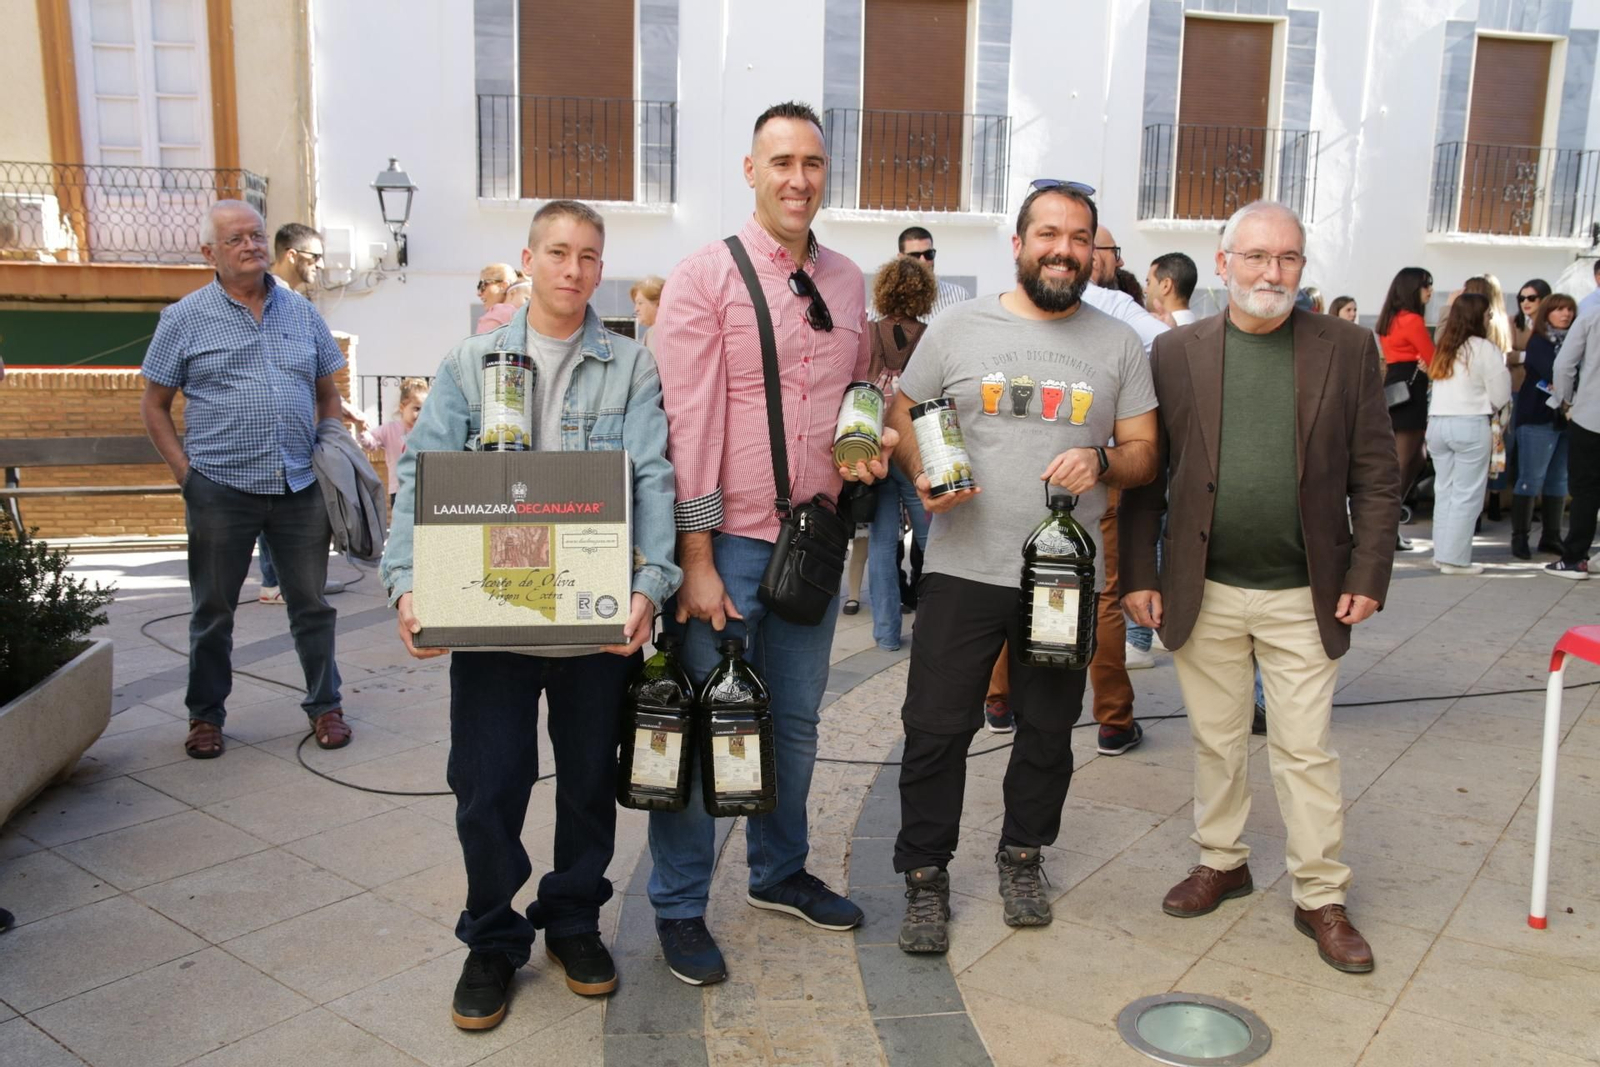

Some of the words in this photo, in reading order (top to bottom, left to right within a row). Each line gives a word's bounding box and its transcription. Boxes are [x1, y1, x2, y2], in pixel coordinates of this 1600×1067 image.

[1026, 350, 1096, 378] DISCRIMINATE!
[461, 572, 512, 590] Aceite
[518, 569, 540, 588] de
[541, 570, 576, 587] Oliva
[488, 588, 520, 606] Virgen
[525, 586, 563, 602] Extra
